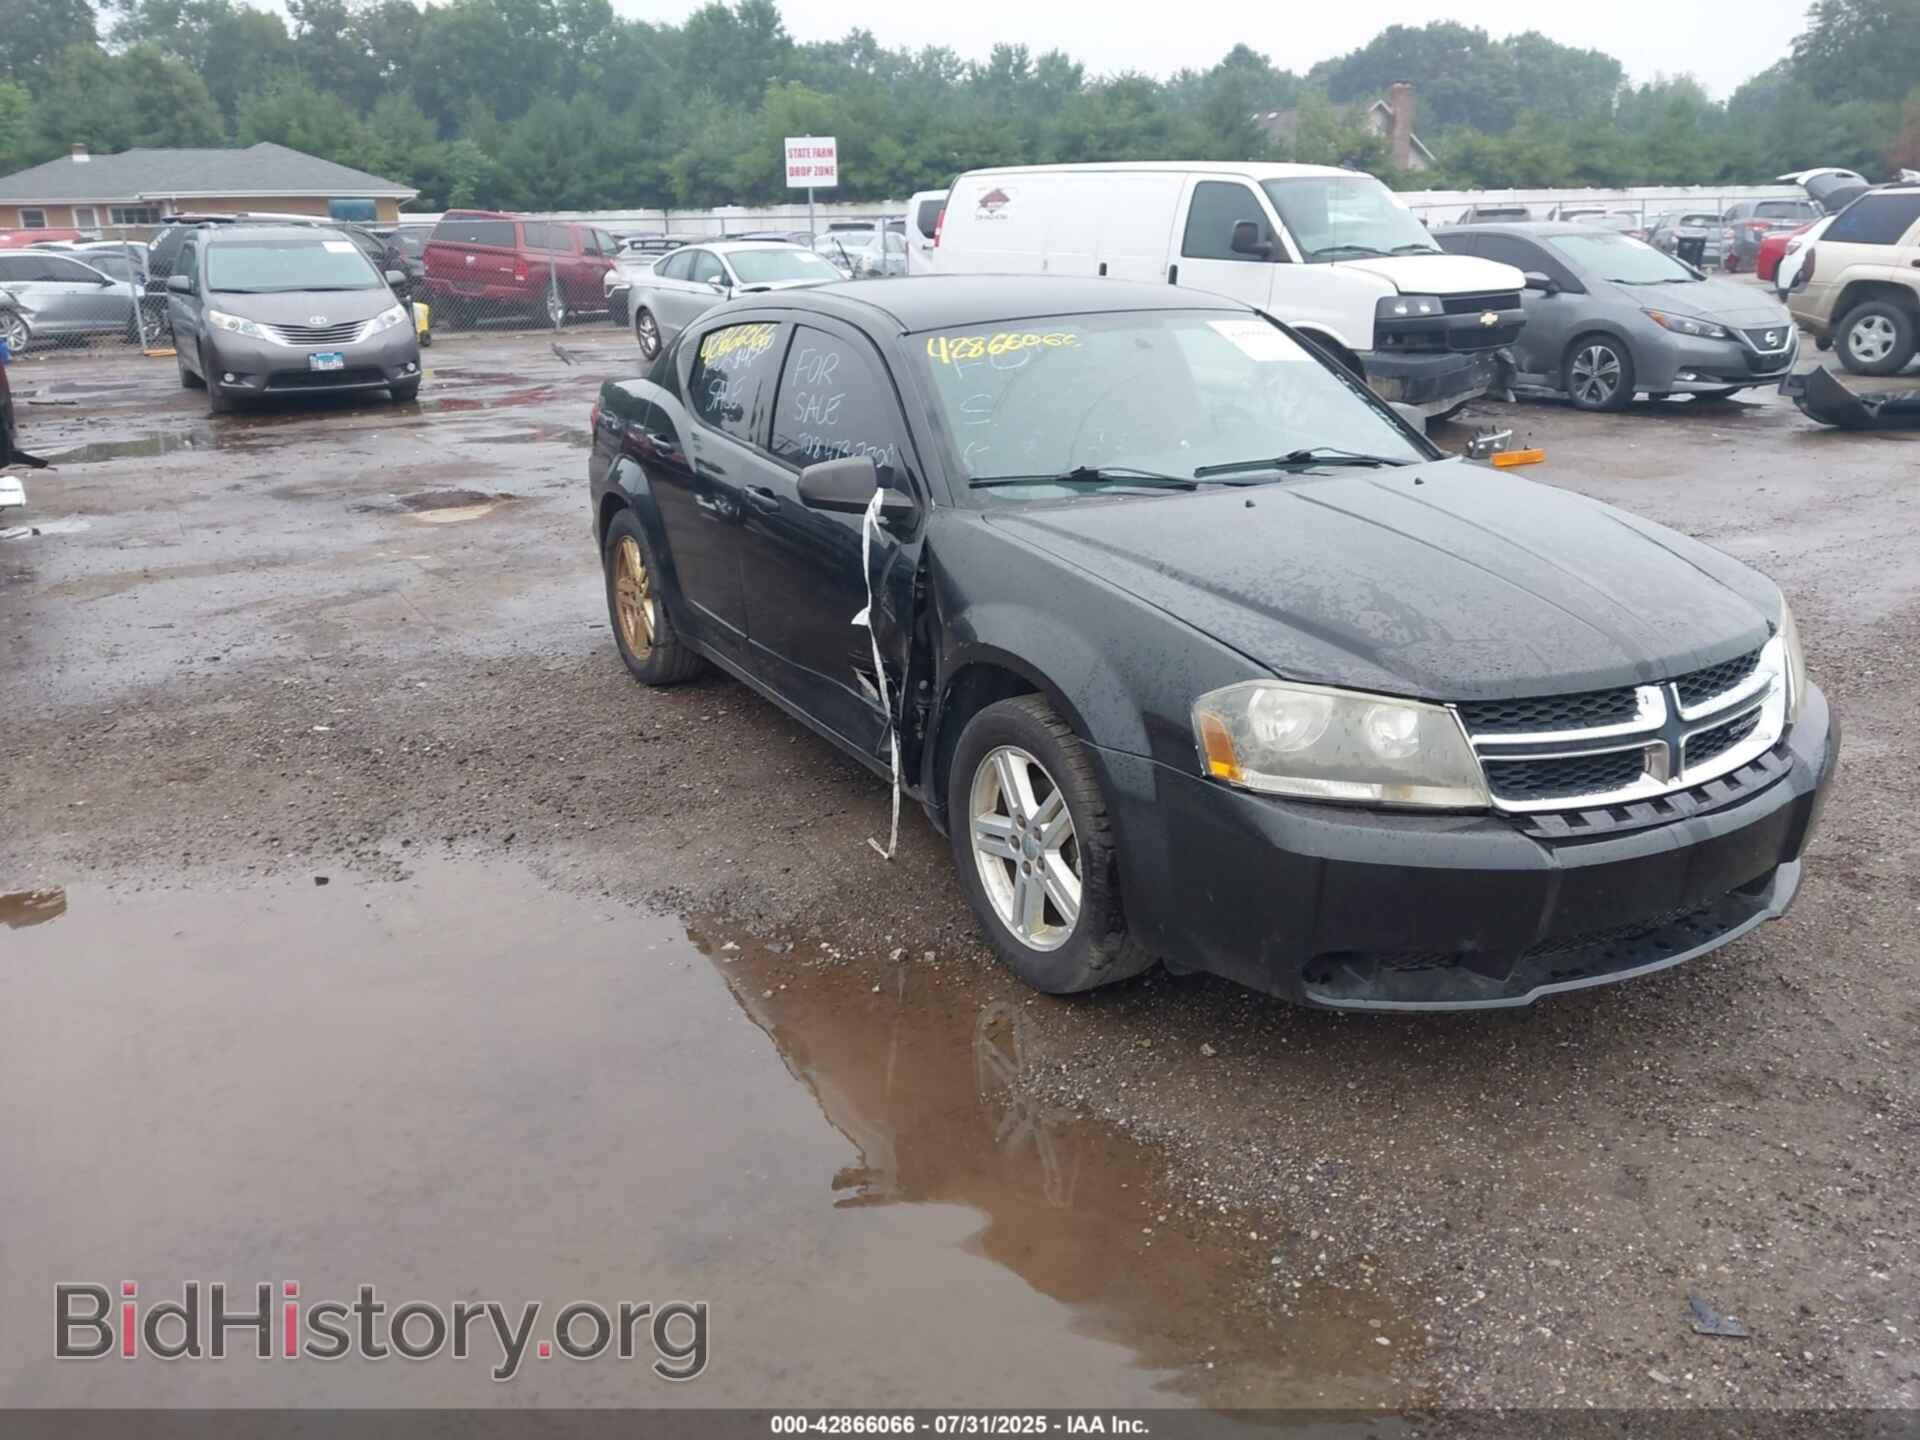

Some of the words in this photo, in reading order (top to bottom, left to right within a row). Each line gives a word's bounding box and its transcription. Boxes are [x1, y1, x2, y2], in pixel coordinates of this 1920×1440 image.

[788, 147, 810, 158] STATE
[812, 147, 833, 157] FARM
[788, 166, 811, 176] DROP
[814, 166, 833, 176] ZONE
[792, 349, 840, 387] FOR
[794, 391, 846, 425] SALE
